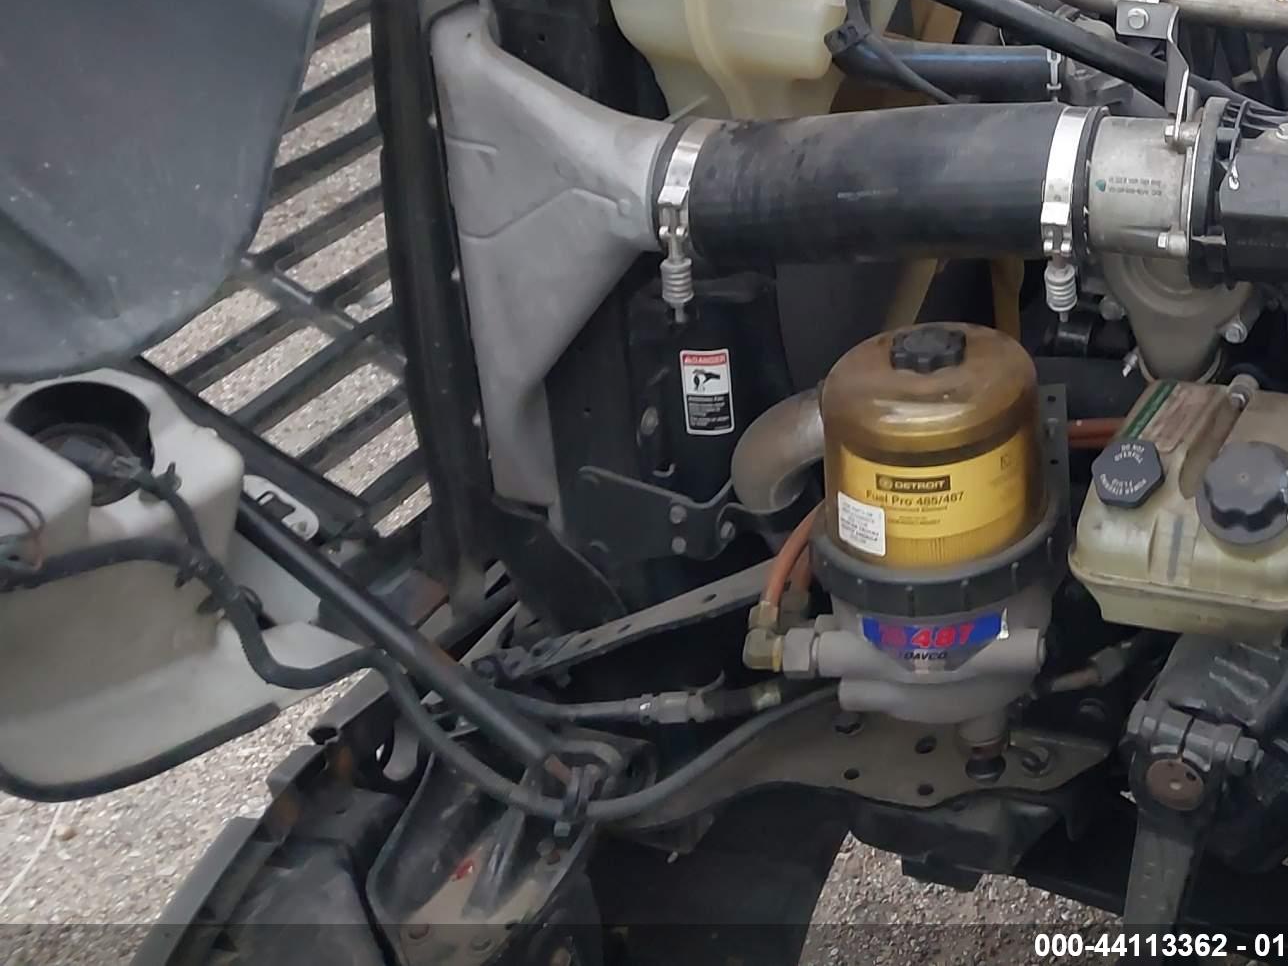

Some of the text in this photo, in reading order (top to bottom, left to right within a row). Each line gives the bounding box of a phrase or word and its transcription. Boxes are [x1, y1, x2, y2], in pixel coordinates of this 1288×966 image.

[894, 480, 946, 490] DETROIT
[866, 490, 888, 503] Fuel
[892, 495, 912, 506] Pro
[904, 651, 949, 660] DAVCO
